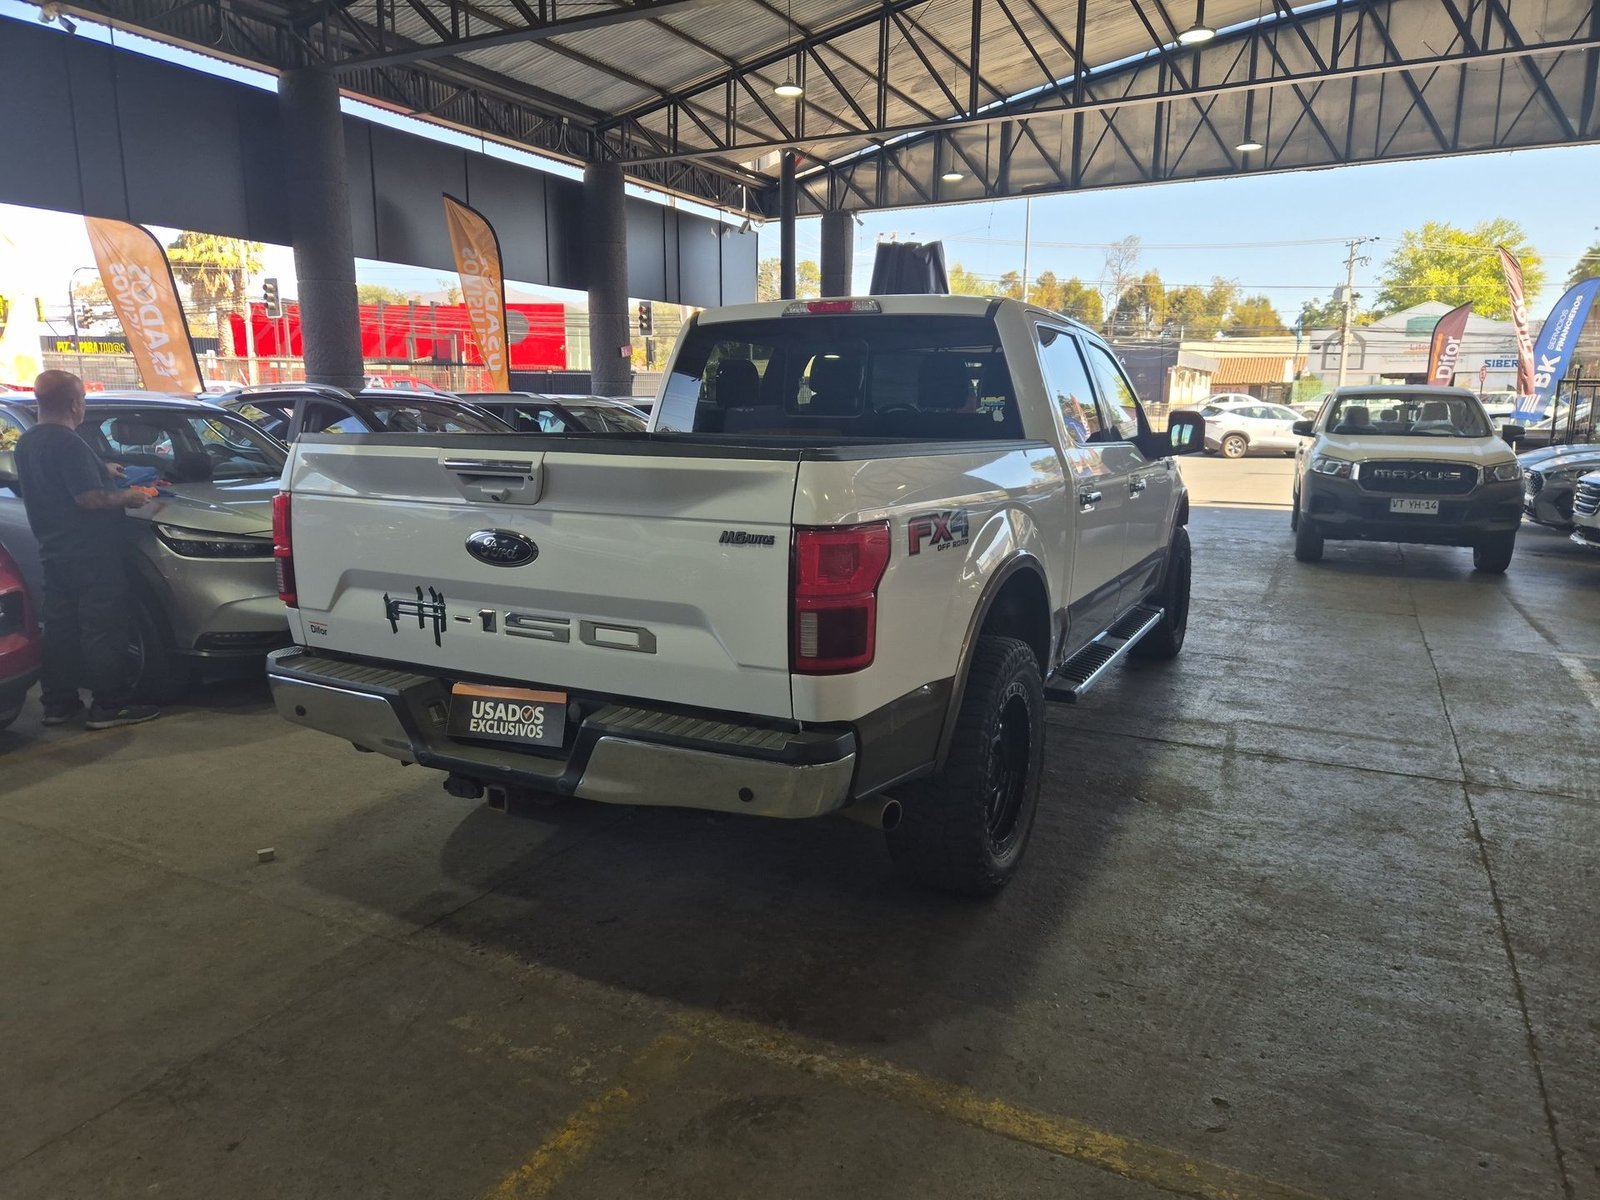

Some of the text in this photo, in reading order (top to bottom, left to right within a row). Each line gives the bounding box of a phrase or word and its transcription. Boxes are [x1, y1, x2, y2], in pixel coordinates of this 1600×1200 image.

[1547, 308, 1569, 351] SERVICIOS
[1555, 295, 1584, 352] FINANCIEROS
[1436, 336, 1461, 379] Difor
[1534, 354, 1561, 388] BK
[1374, 469, 1462, 480] MAXUS
[1392, 500, 1404, 509] VT
[908, 508, 969, 557] FX4
[480, 536, 520, 560] Ford
[937, 542, 951, 552] OFF
[471, 700, 545, 725] USADOS
[469, 718, 544, 739] EXCLUSIVOS
